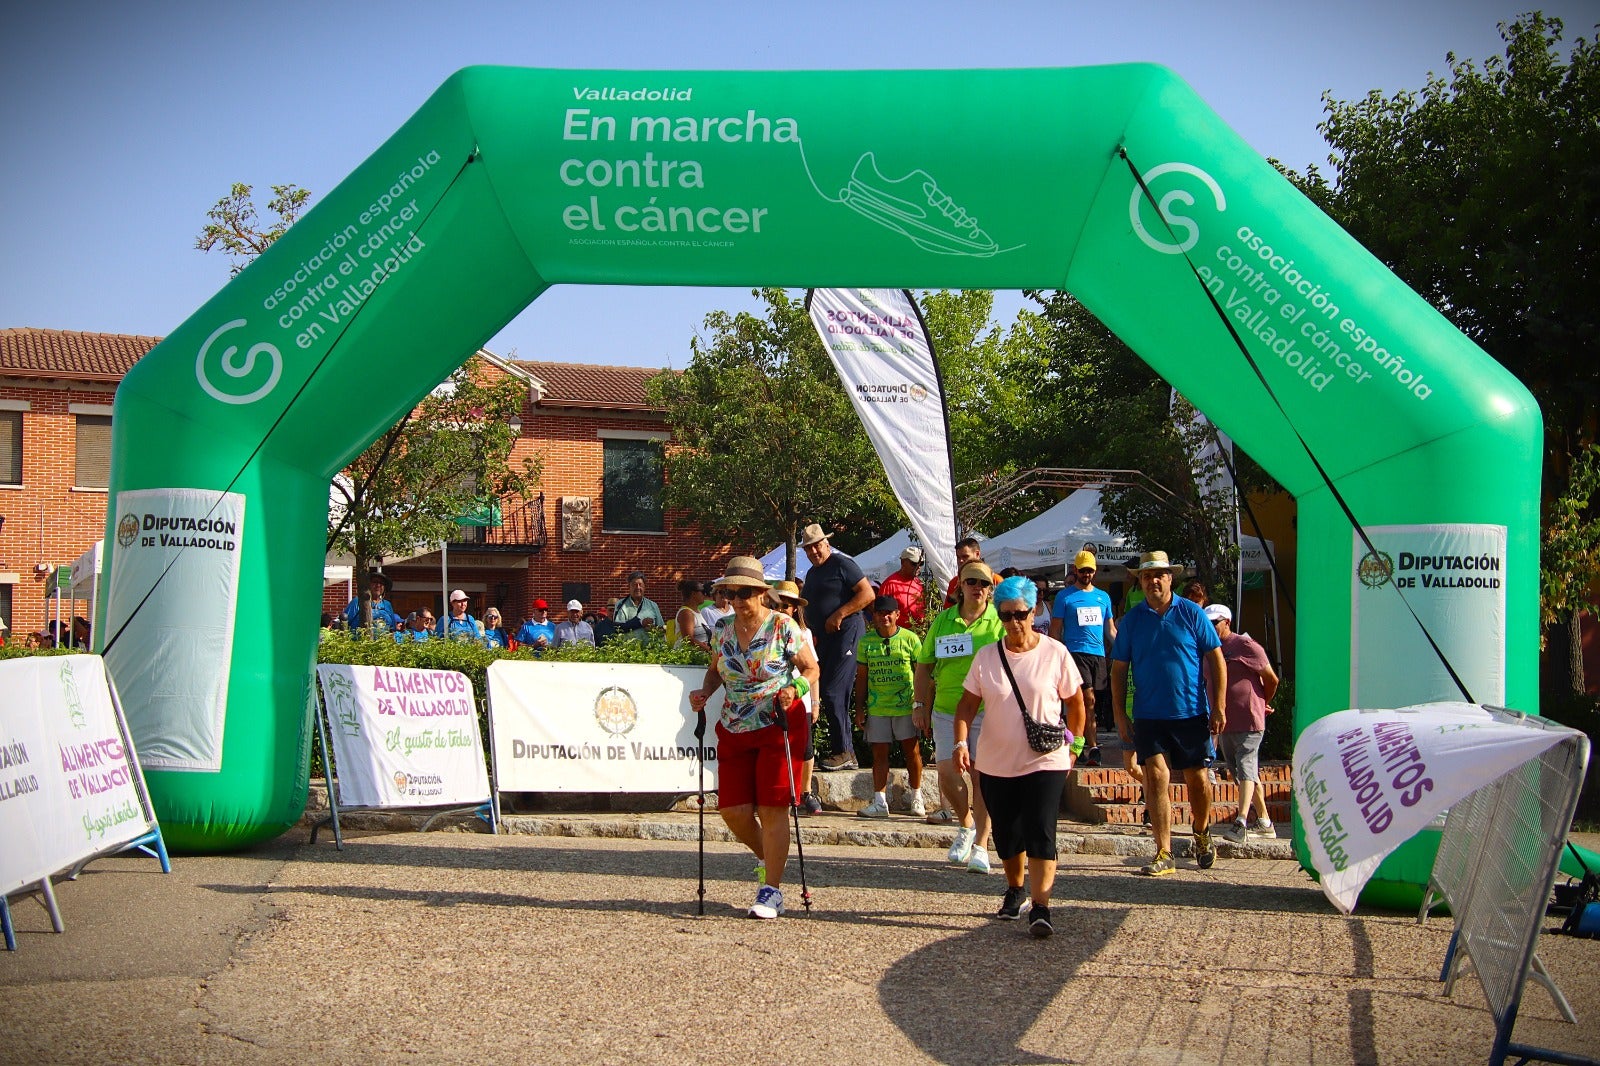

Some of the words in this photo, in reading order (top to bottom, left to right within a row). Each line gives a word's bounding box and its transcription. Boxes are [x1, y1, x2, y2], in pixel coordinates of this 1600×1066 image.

[572, 87, 692, 101] Valladolid
[562, 108, 616, 142] En
[630, 110, 800, 144] marcha
[559, 151, 704, 189] contra
[562, 196, 606, 231] el
[614, 197, 768, 233] cáncer
[263, 224, 358, 310] asociación
[359, 149, 441, 225] española
[278, 272, 339, 329] contra
[339, 253, 359, 276] el
[358, 199, 420, 259] cáncer
[295, 321, 326, 349] en
[319, 231, 426, 325] Valladolid
[1216, 245, 1281, 305] contra
[1280, 301, 1306, 324] el
[1301, 321, 1373, 384] cáncer
[1236, 226, 1340, 320] asociación
[1339, 317, 1433, 400] española
[1195, 265, 1225, 295] en
[1225, 287, 1334, 392] Valladolid
[142, 514, 235, 535] DIPUTACIÓN
[142, 537, 155, 547] DE
[160, 534, 235, 551] VALLADOLID
[1399, 552, 1500, 571] DIPUTACIÓN
[1398, 577, 1415, 588] DE
[1421, 574, 1500, 589] VALLADOLID
[1084, 614, 1098, 623] 337
[944, 644, 965, 655] 134
[374, 666, 465, 694] ALIMENTOS
[377, 698, 396, 716] DE
[396, 696, 469, 717] VALLADOLID
[434, 729, 448, 748] de
[512, 739, 601, 760] DIPUTACIÓN
[607, 745, 626, 761] DE
[1339, 734, 1393, 834] VALLADOLID
